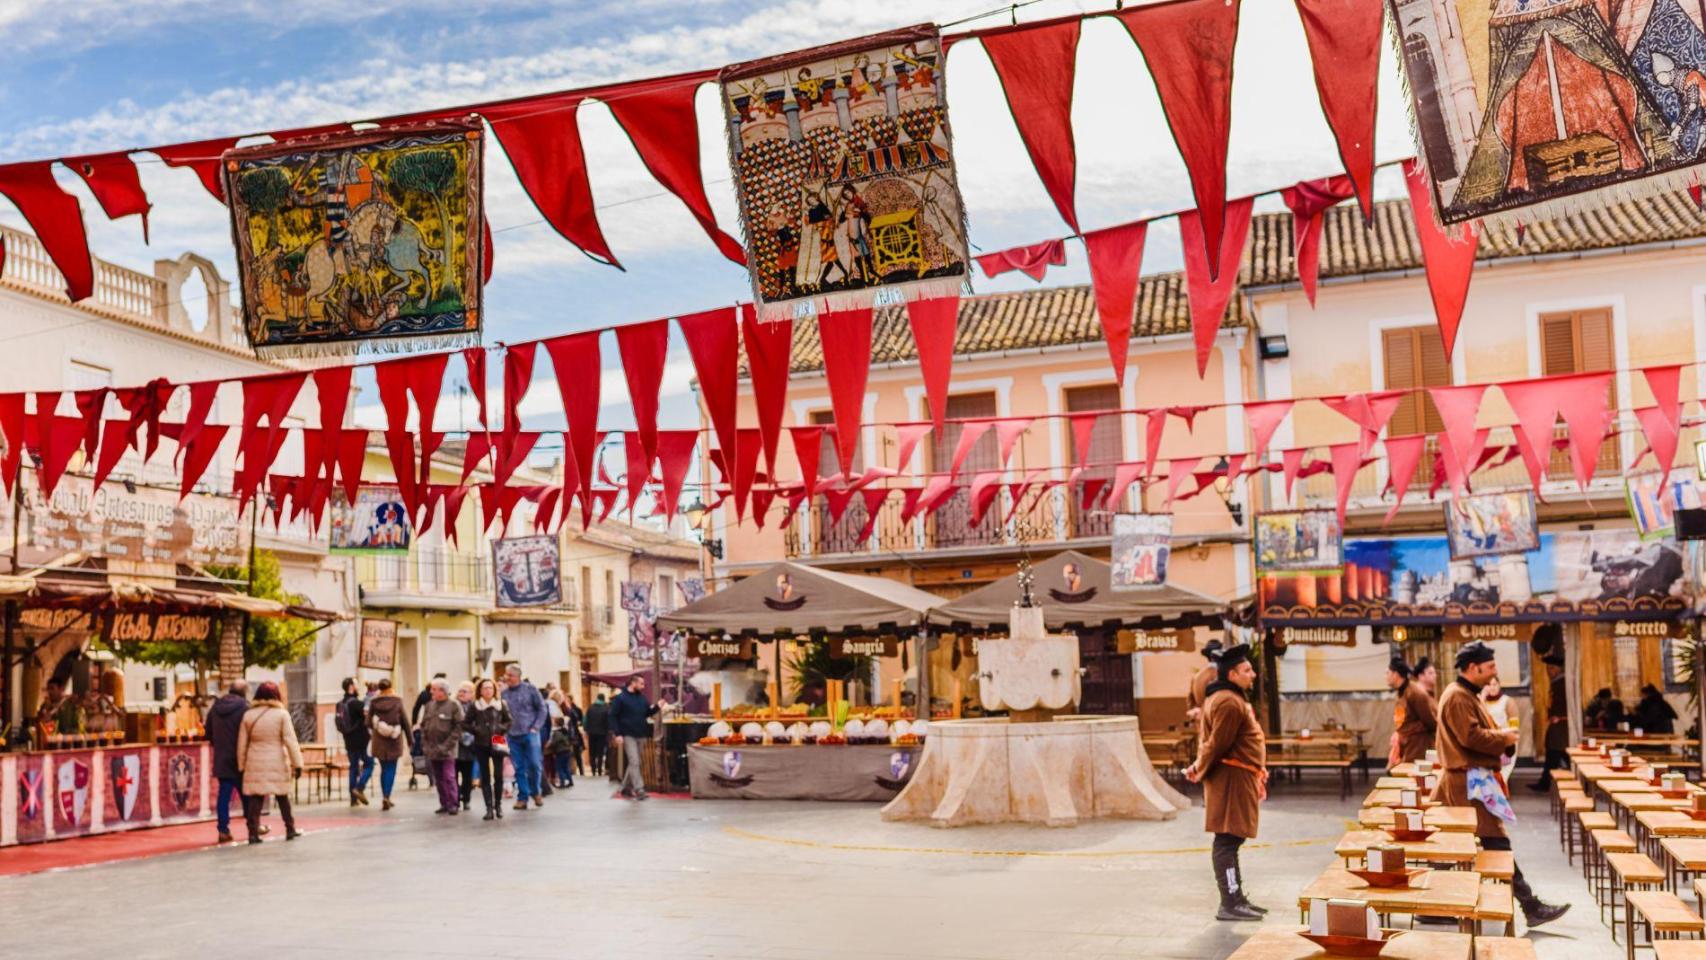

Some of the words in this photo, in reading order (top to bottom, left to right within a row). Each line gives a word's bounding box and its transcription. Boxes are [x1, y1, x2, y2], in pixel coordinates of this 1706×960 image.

[94, 486, 174, 524] Artesanos
[1283, 627, 1349, 643] Puntillitas
[1460, 624, 1516, 638] Chorizos
[1615, 621, 1668, 637] Secreto
[698, 640, 740, 655] Chorizos
[1134, 632, 1178, 650] Bravas
